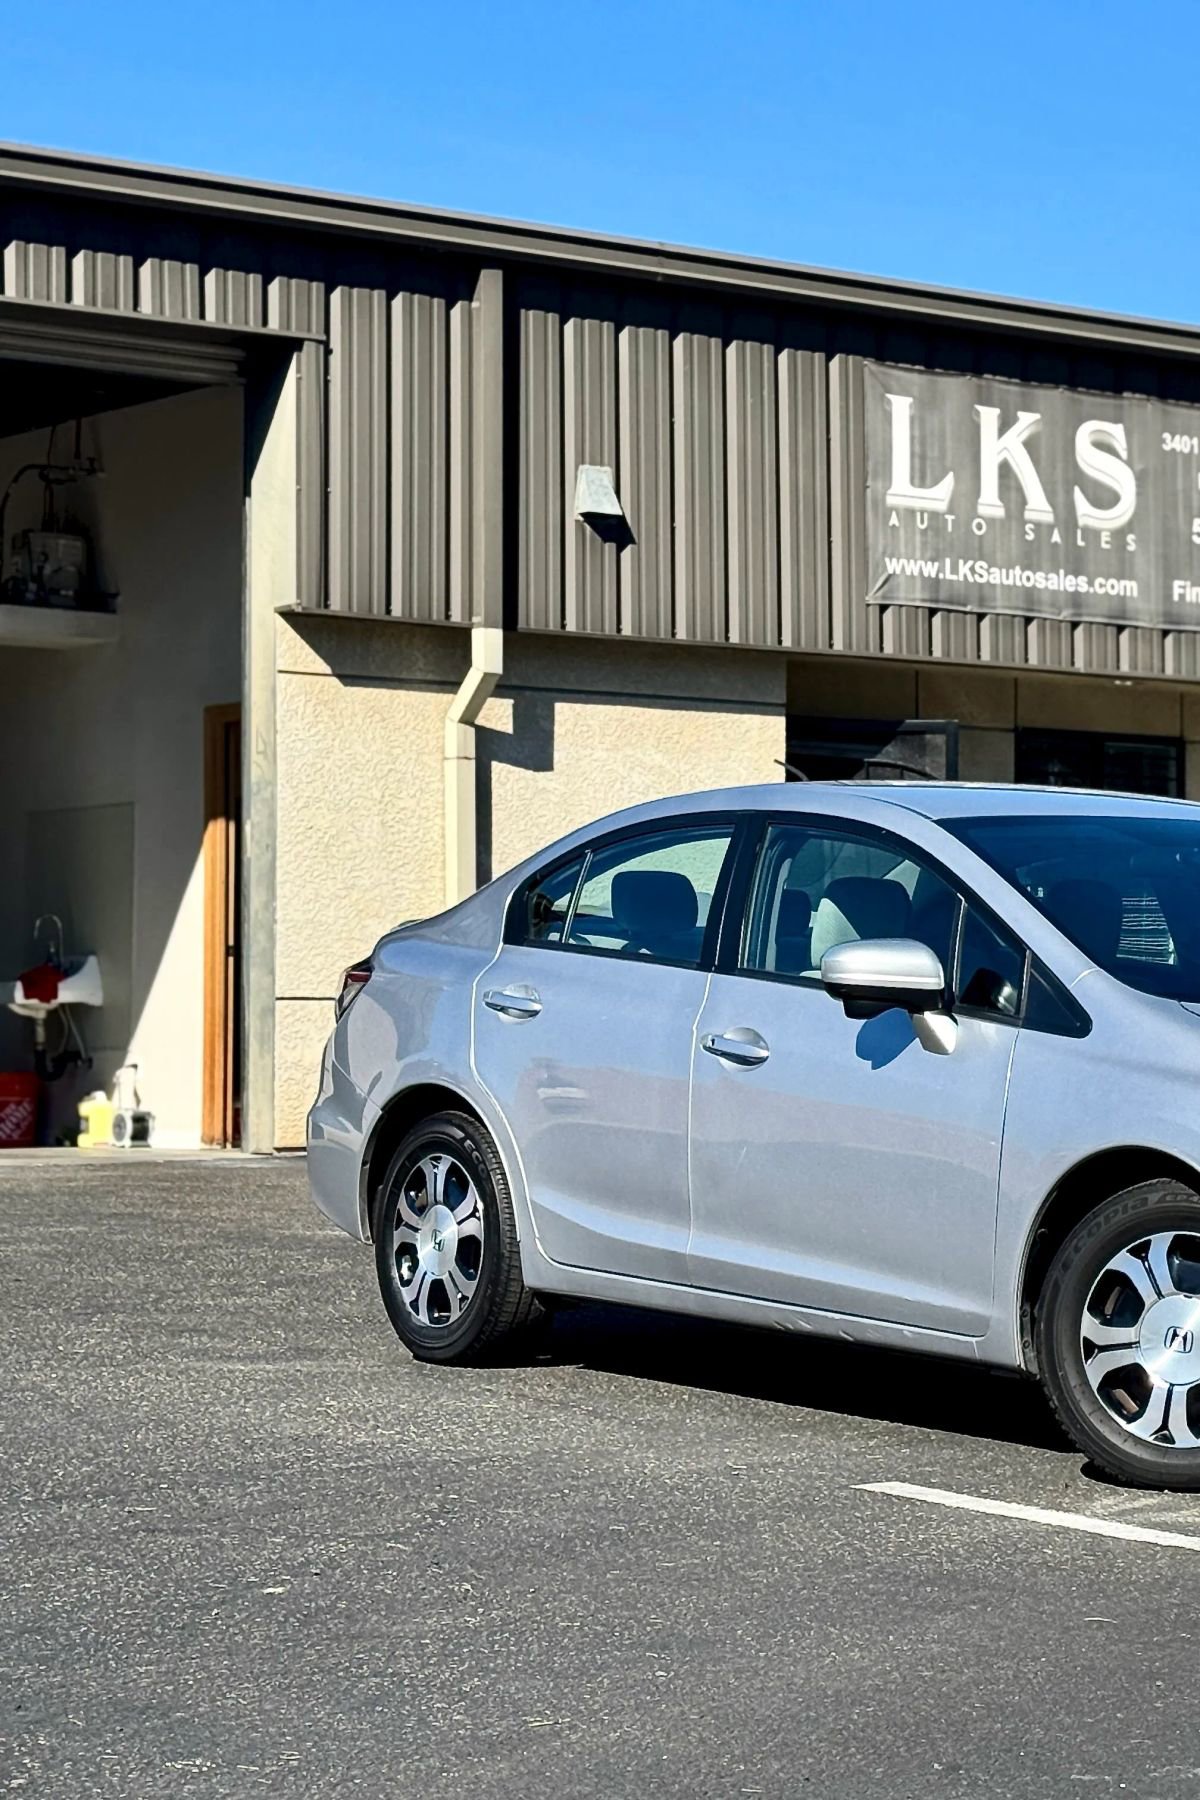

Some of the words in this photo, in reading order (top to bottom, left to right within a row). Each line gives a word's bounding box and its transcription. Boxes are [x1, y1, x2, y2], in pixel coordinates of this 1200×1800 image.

[885, 393, 1137, 529] LKS
[1161, 432, 1199, 454] 3401
[888, 510, 987, 536] AUTO
[1024, 523, 1137, 552] SALES
[885, 556, 1138, 598] www.LKSautosales.com
